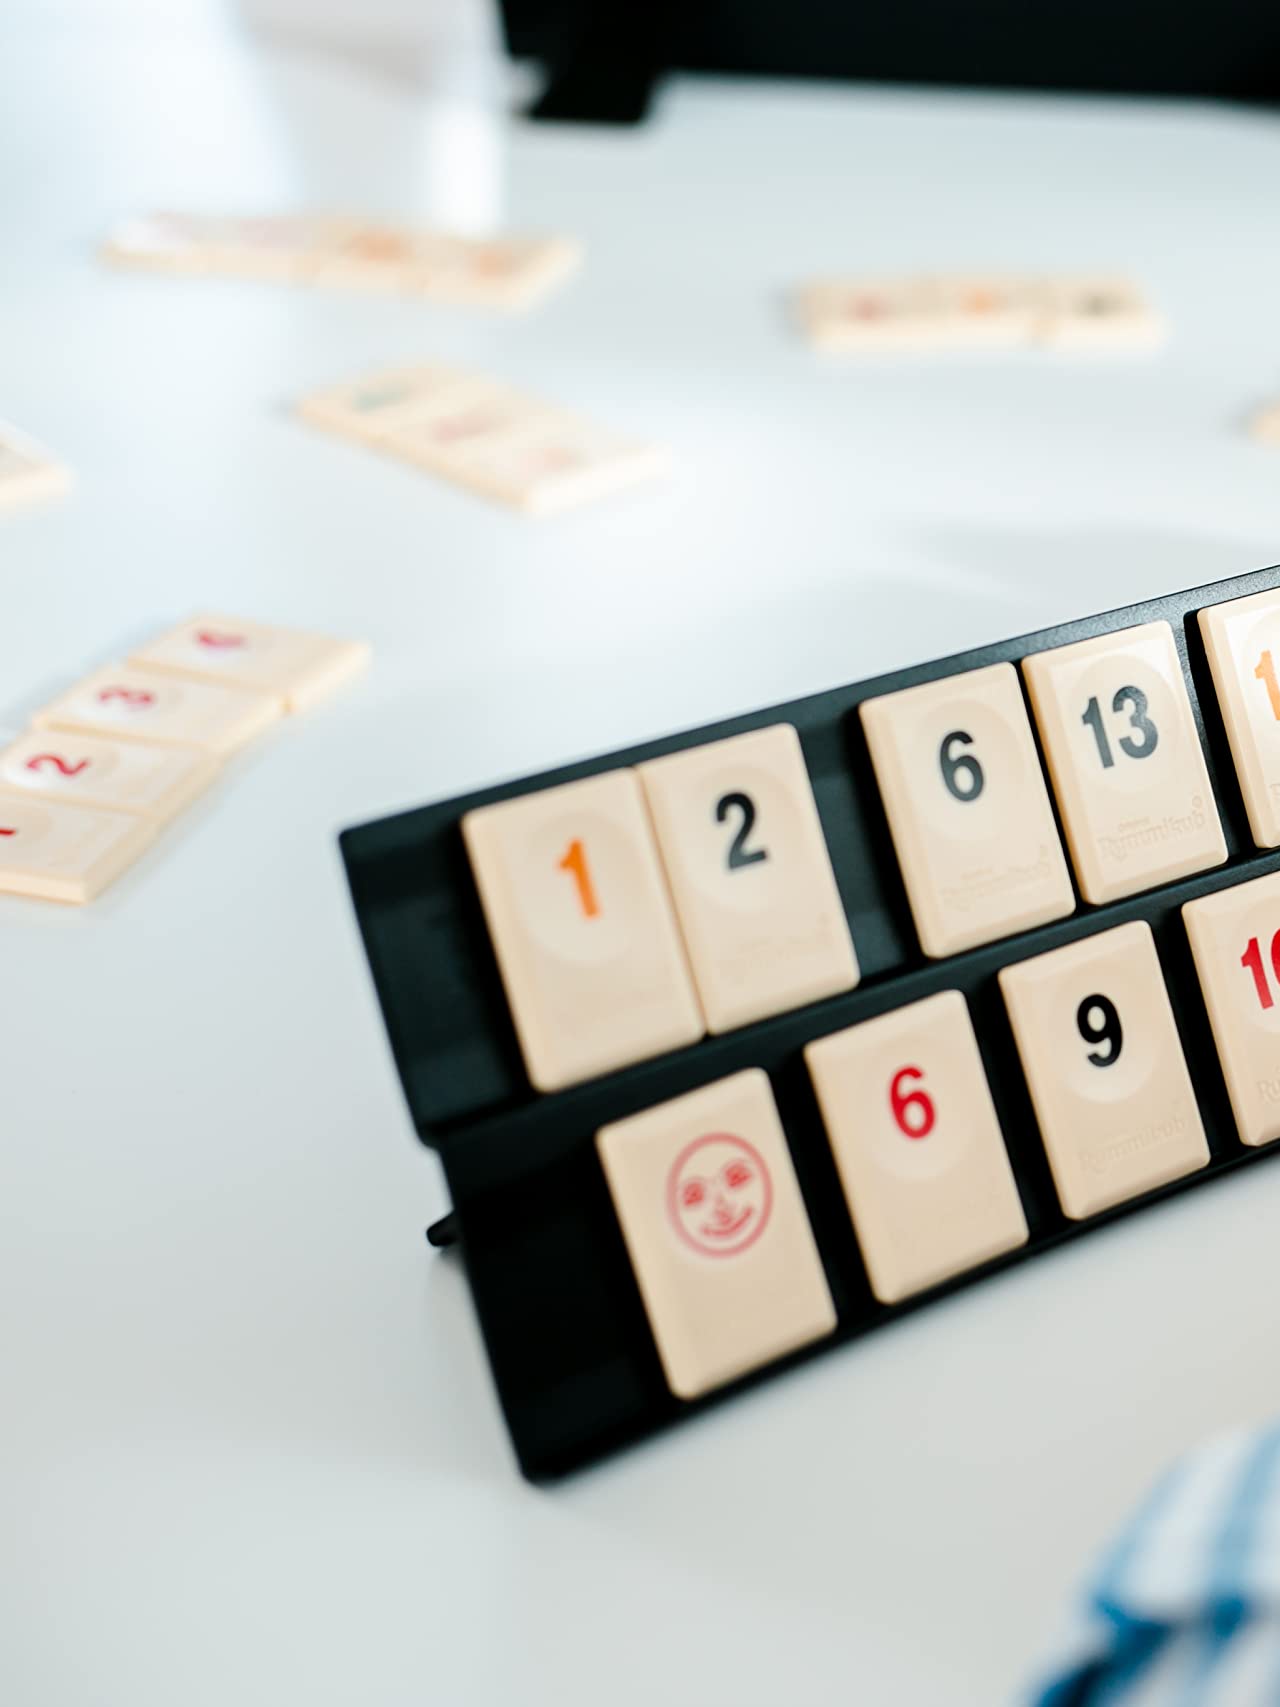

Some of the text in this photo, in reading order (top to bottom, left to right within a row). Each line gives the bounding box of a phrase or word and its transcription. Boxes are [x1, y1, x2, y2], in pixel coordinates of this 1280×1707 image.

[26, 752, 90, 777] 2
[1081, 684, 1159, 769] 13
[938, 729, 986, 803] 6
[713, 790, 768, 871] 2
[556, 837, 601, 921] 1
[1076, 992, 1124, 1069] 9
[888, 1065, 937, 1141] 6
